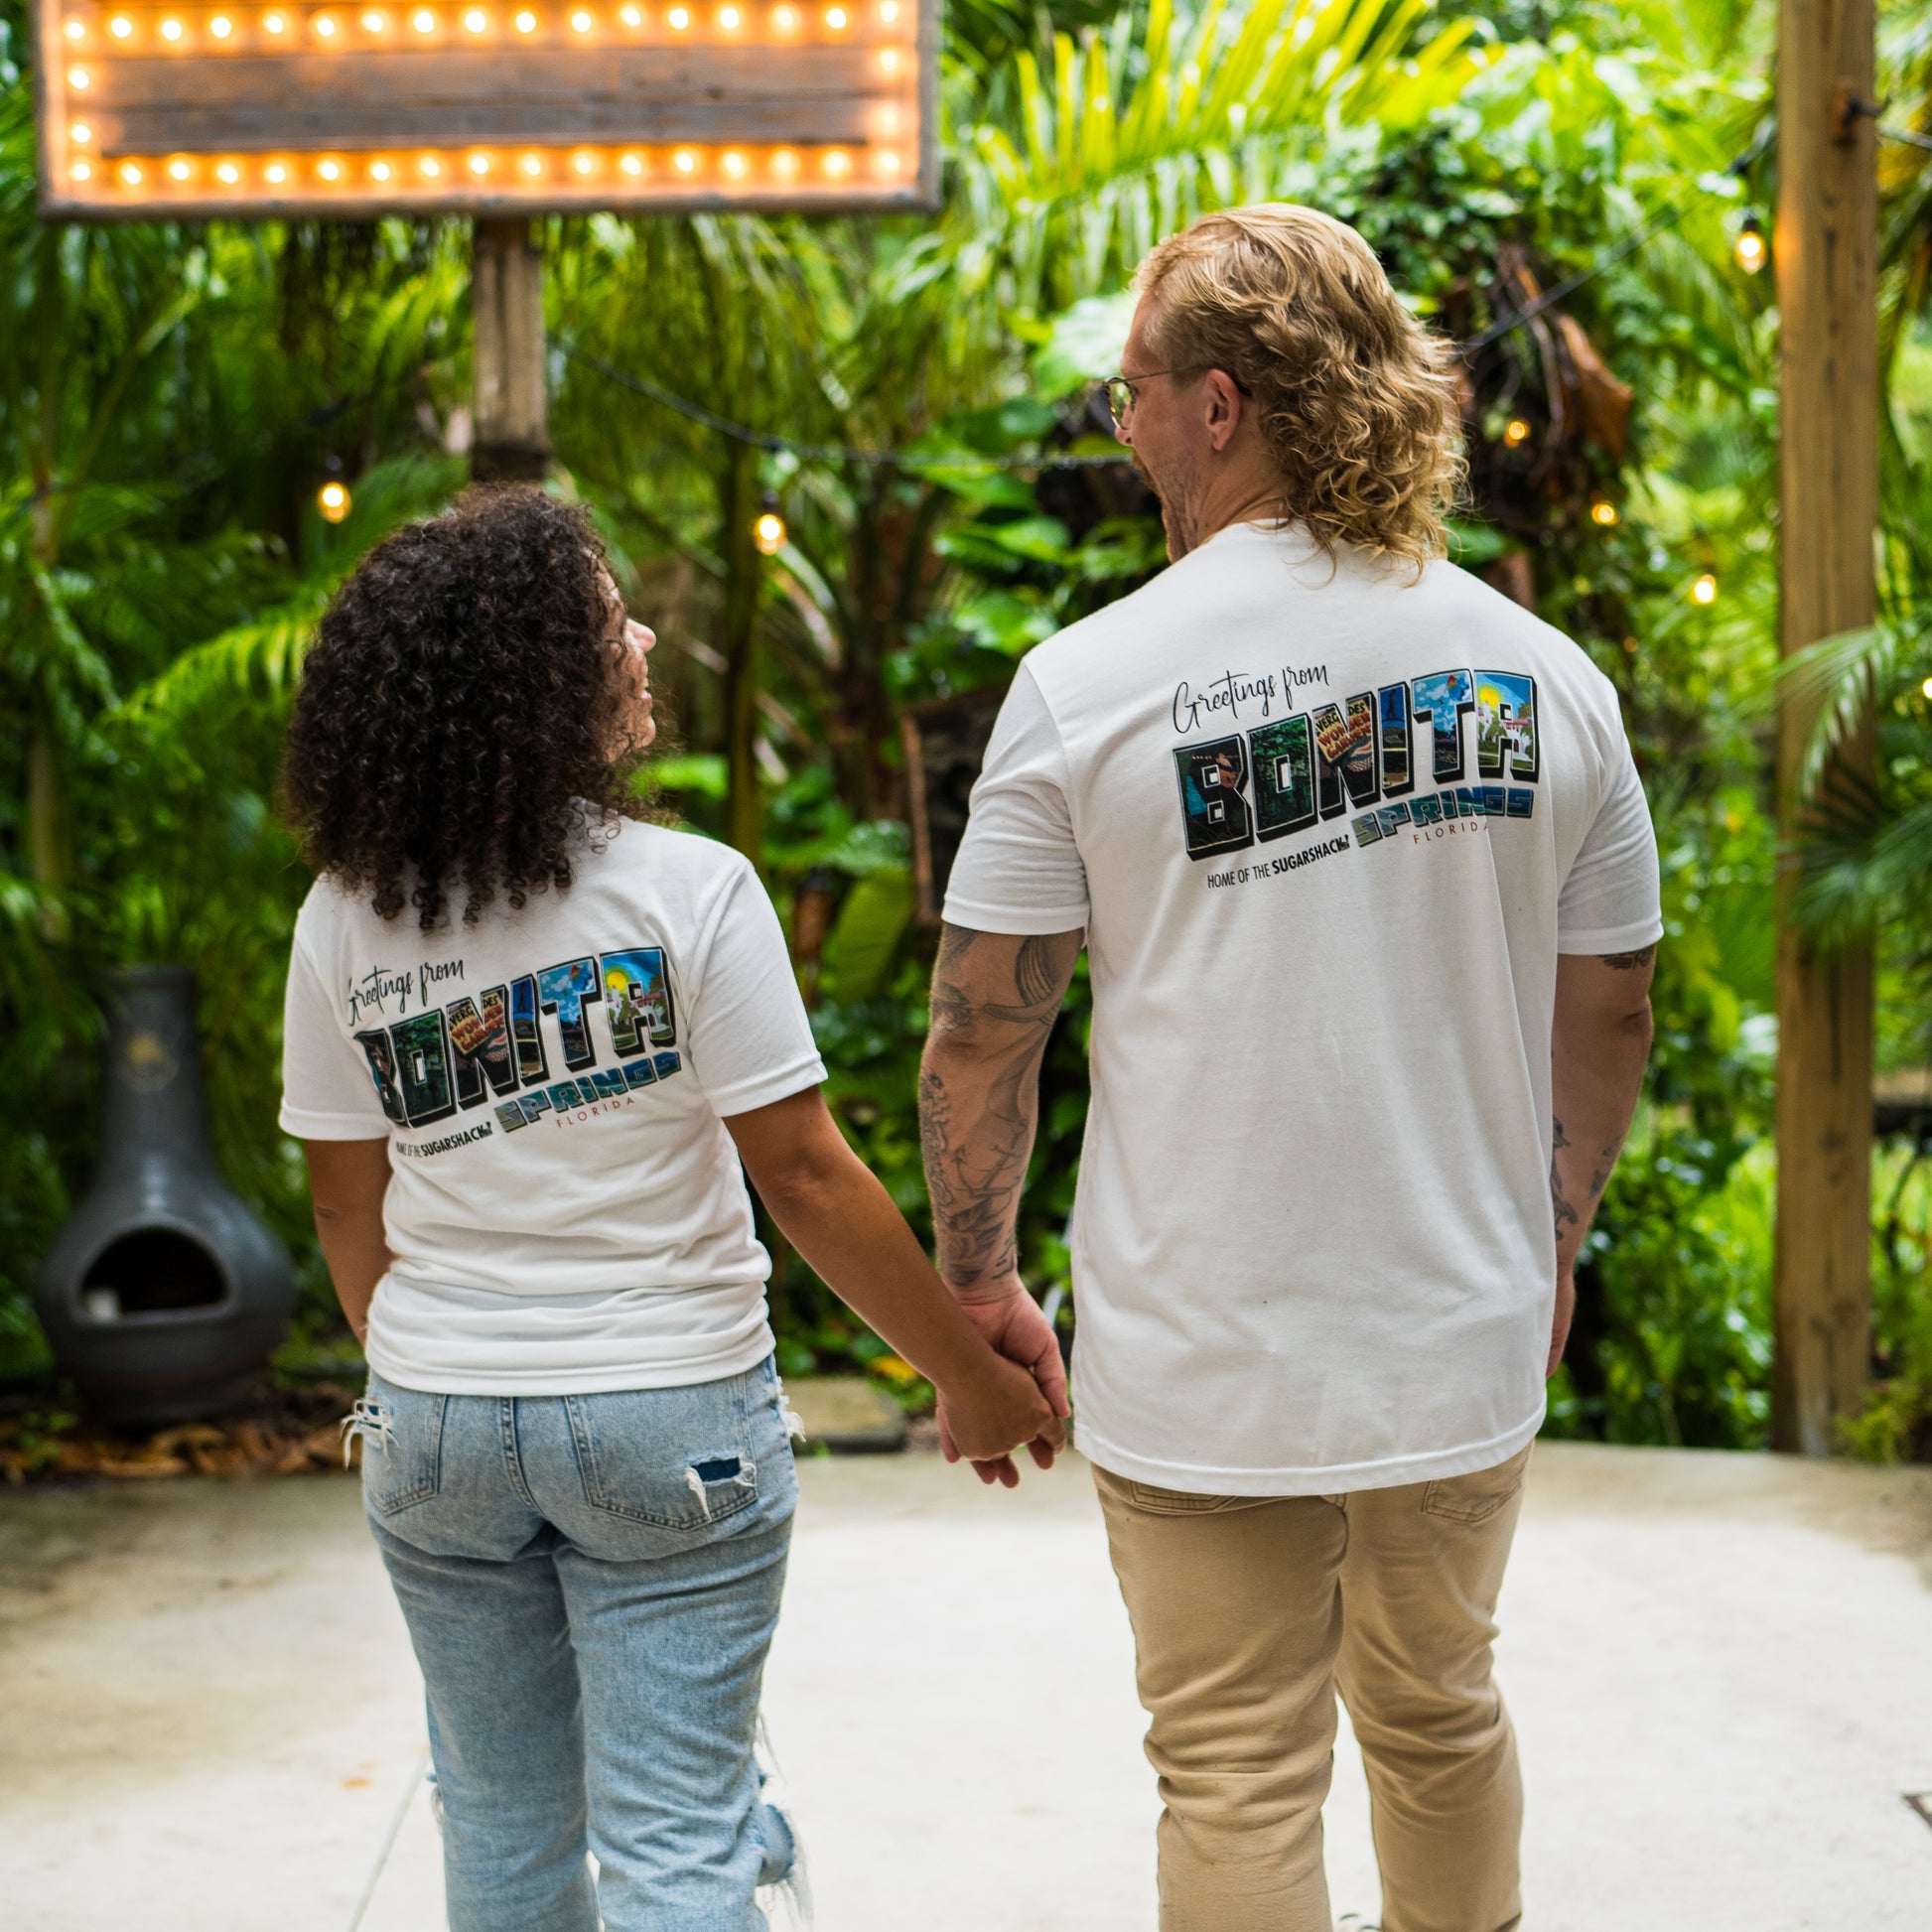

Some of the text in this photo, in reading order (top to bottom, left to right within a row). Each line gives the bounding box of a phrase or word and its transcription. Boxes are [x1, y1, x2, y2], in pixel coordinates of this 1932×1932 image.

[1173, 664, 1328, 734] Greetings from
[1173, 668, 1540, 861] BONITA
[1350, 786, 1535, 848] SPRINGS
[1207, 871, 1236, 890] HOME
[1237, 868, 1250, 884] OF
[1252, 863, 1271, 881] THE
[419, 959, 466, 1007] from
[492, 1050, 682, 1133] SPRINGS
[556, 1096, 635, 1129] FLORIDA
